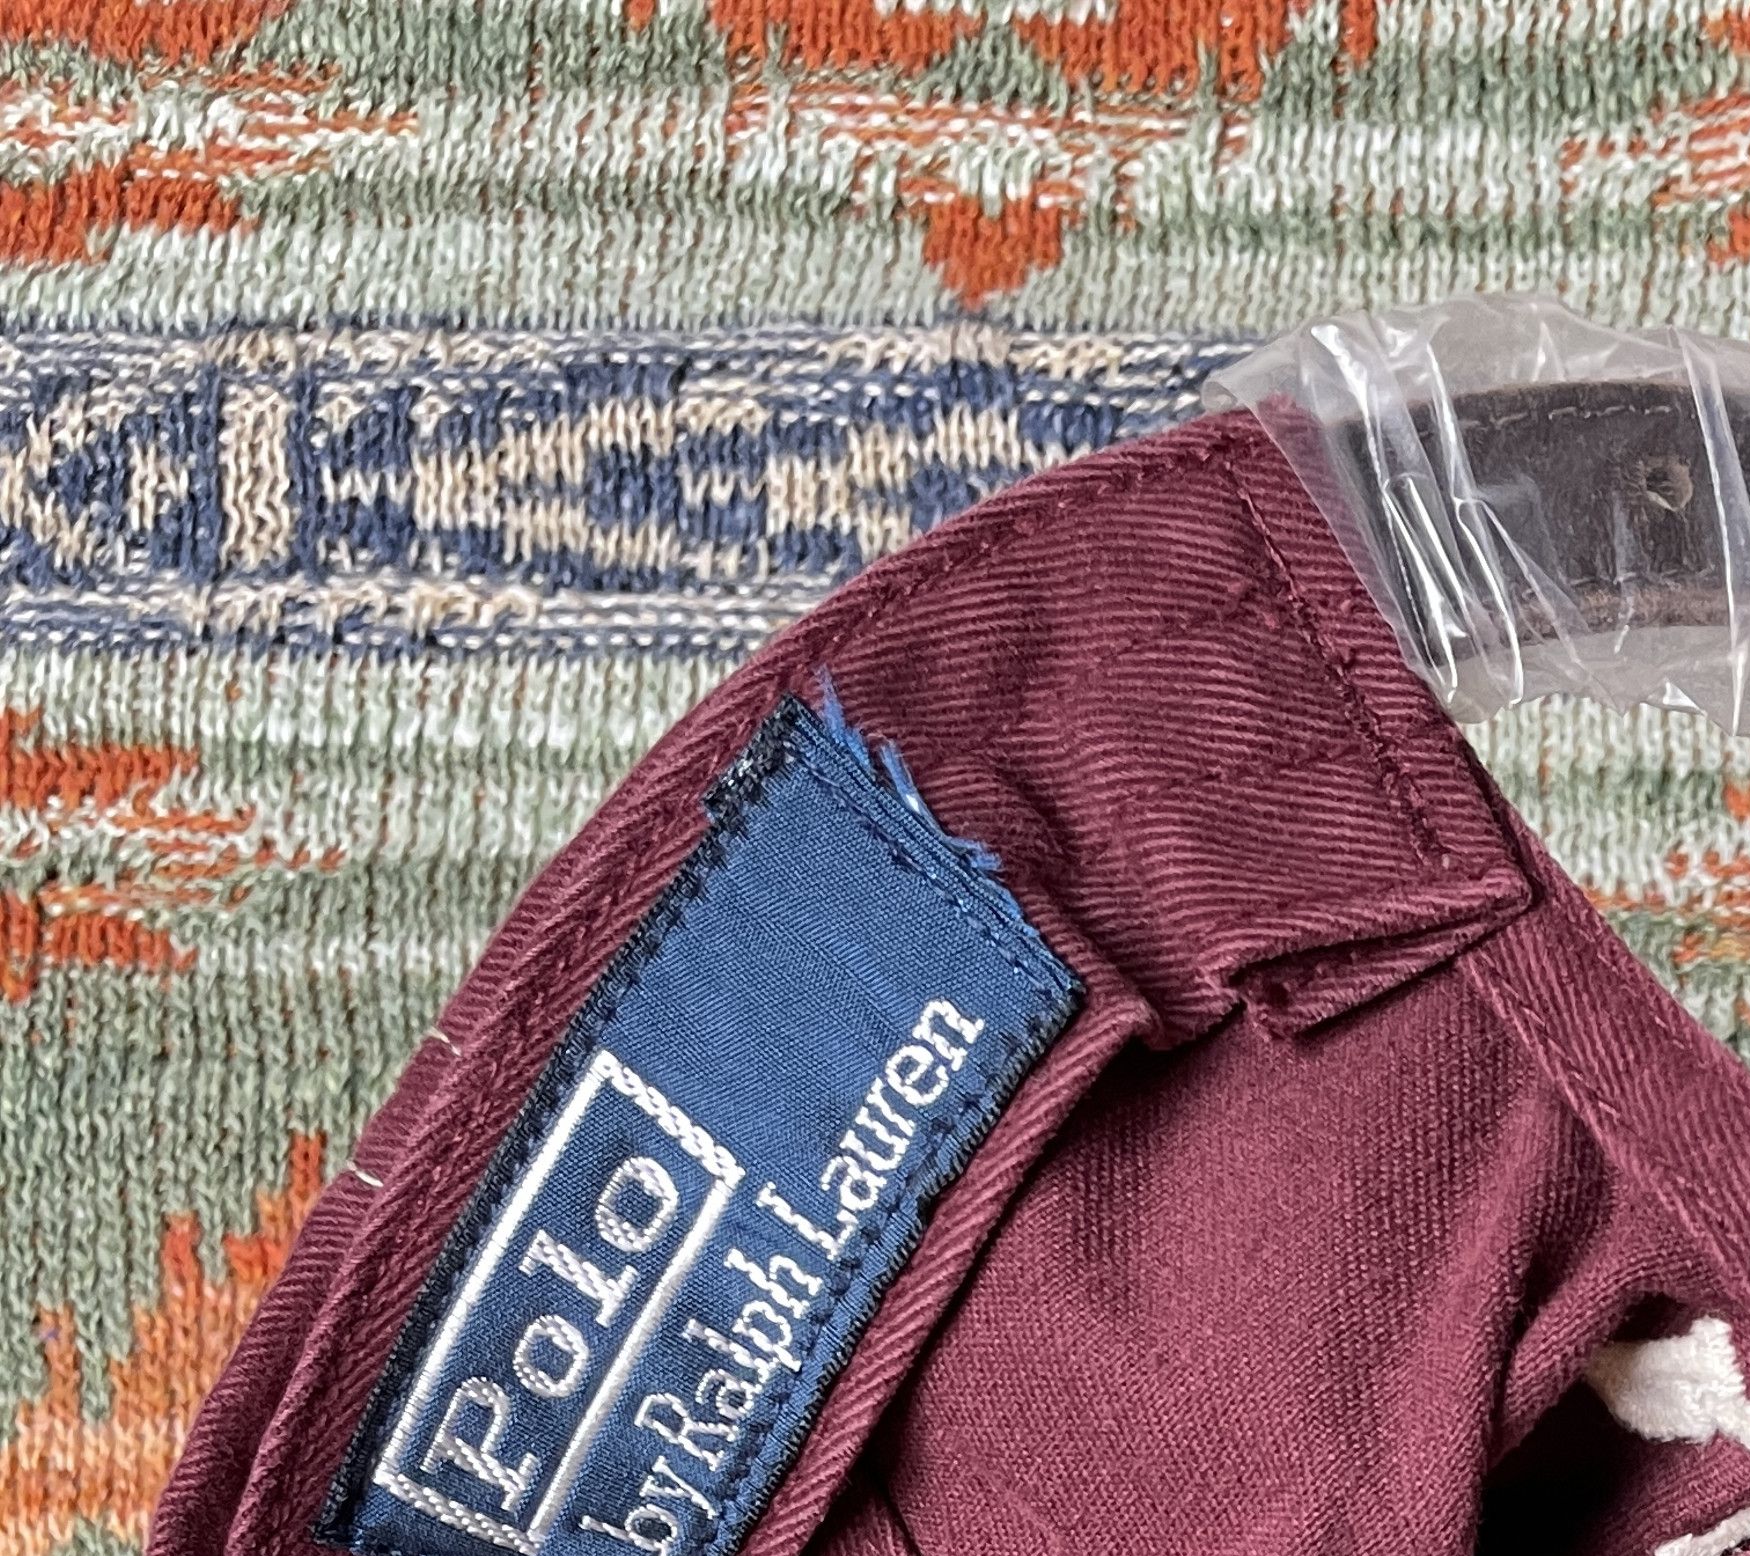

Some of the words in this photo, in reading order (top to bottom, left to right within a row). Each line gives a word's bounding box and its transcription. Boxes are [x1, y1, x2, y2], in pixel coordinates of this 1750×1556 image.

[424, 1156, 679, 1512] Polo
[634, 1250, 821, 1473] Ralph
[756, 996, 986, 1262] Lauren
